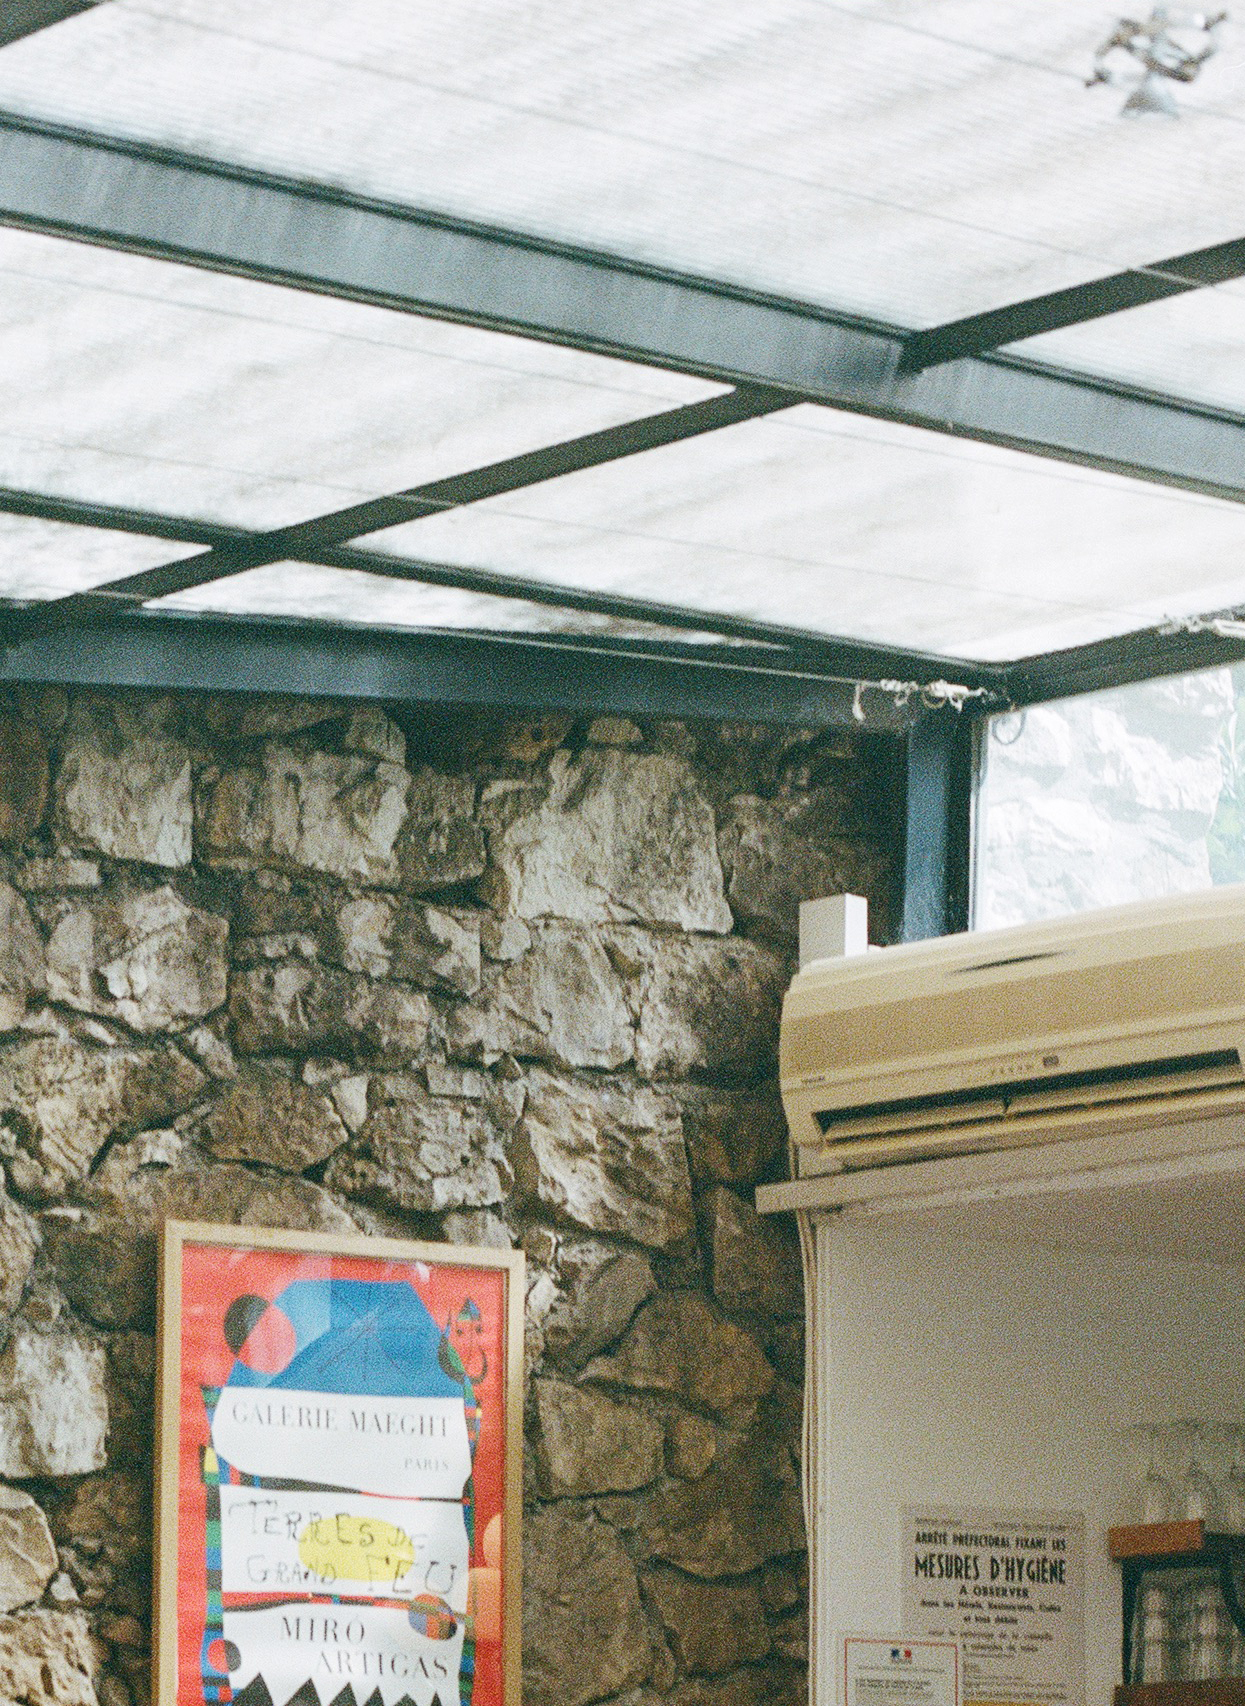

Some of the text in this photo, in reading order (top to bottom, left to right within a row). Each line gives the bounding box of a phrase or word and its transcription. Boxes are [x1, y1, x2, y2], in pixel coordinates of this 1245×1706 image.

[233, 1401, 451, 1438] GALERIE MAEGHT
[405, 1457, 449, 1471] PARIS
[914, 1553, 980, 1581] MESURES
[973, 1585, 1029, 1599] OBSERVER
[317, 1651, 448, 1680] ARTIGAS
